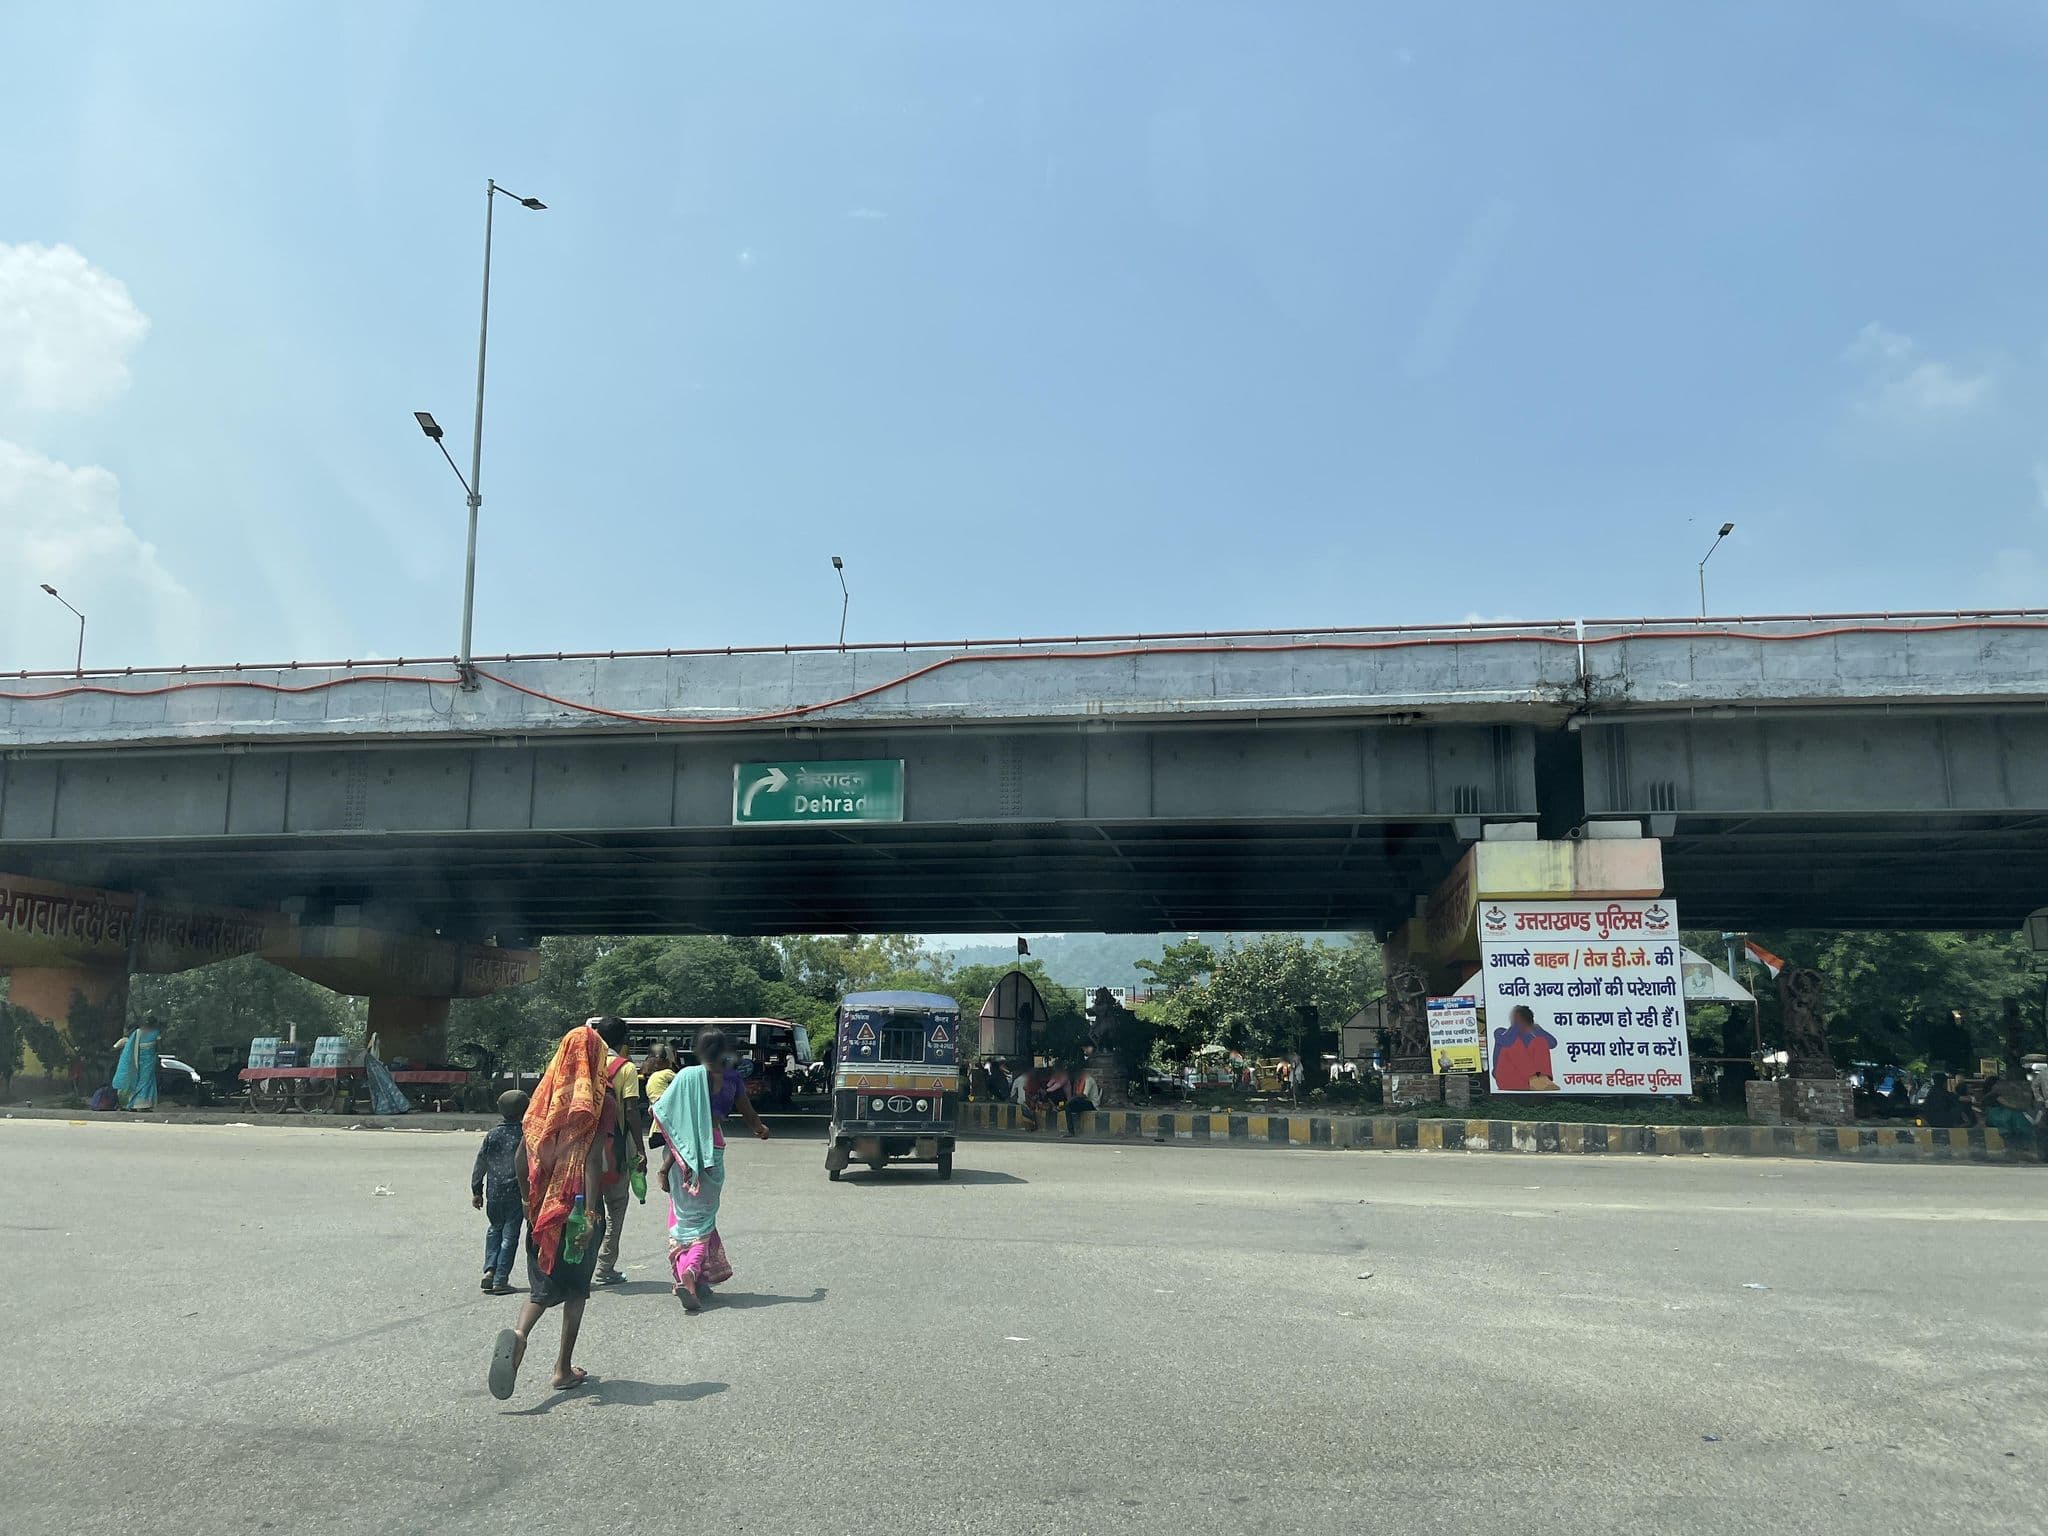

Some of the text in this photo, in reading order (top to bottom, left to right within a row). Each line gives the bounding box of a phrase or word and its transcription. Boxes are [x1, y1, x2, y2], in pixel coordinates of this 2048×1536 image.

[1514, 904, 1643, 939] उत्तराखण्ड पुलिस
[1490, 946, 1675, 970] आपके वाहन / तेज डी.जे. की
[1499, 976, 1677, 997] ध्वनि अन्य लोगों की परेशानी
[1553, 1011, 1573, 1027] का
[1576, 1011, 1614, 1027] कारण
[1617, 1006, 1632, 1028] हो
[1635, 1005, 1658, 1028] रही
[1566, 1041, 1606, 1062] कृपया
[1609, 1036, 1635, 1057] शोर
[1637, 1041, 1650, 1057] न
[1563, 1068, 1682, 1092] जनपद हरिद्वार पुलिस
